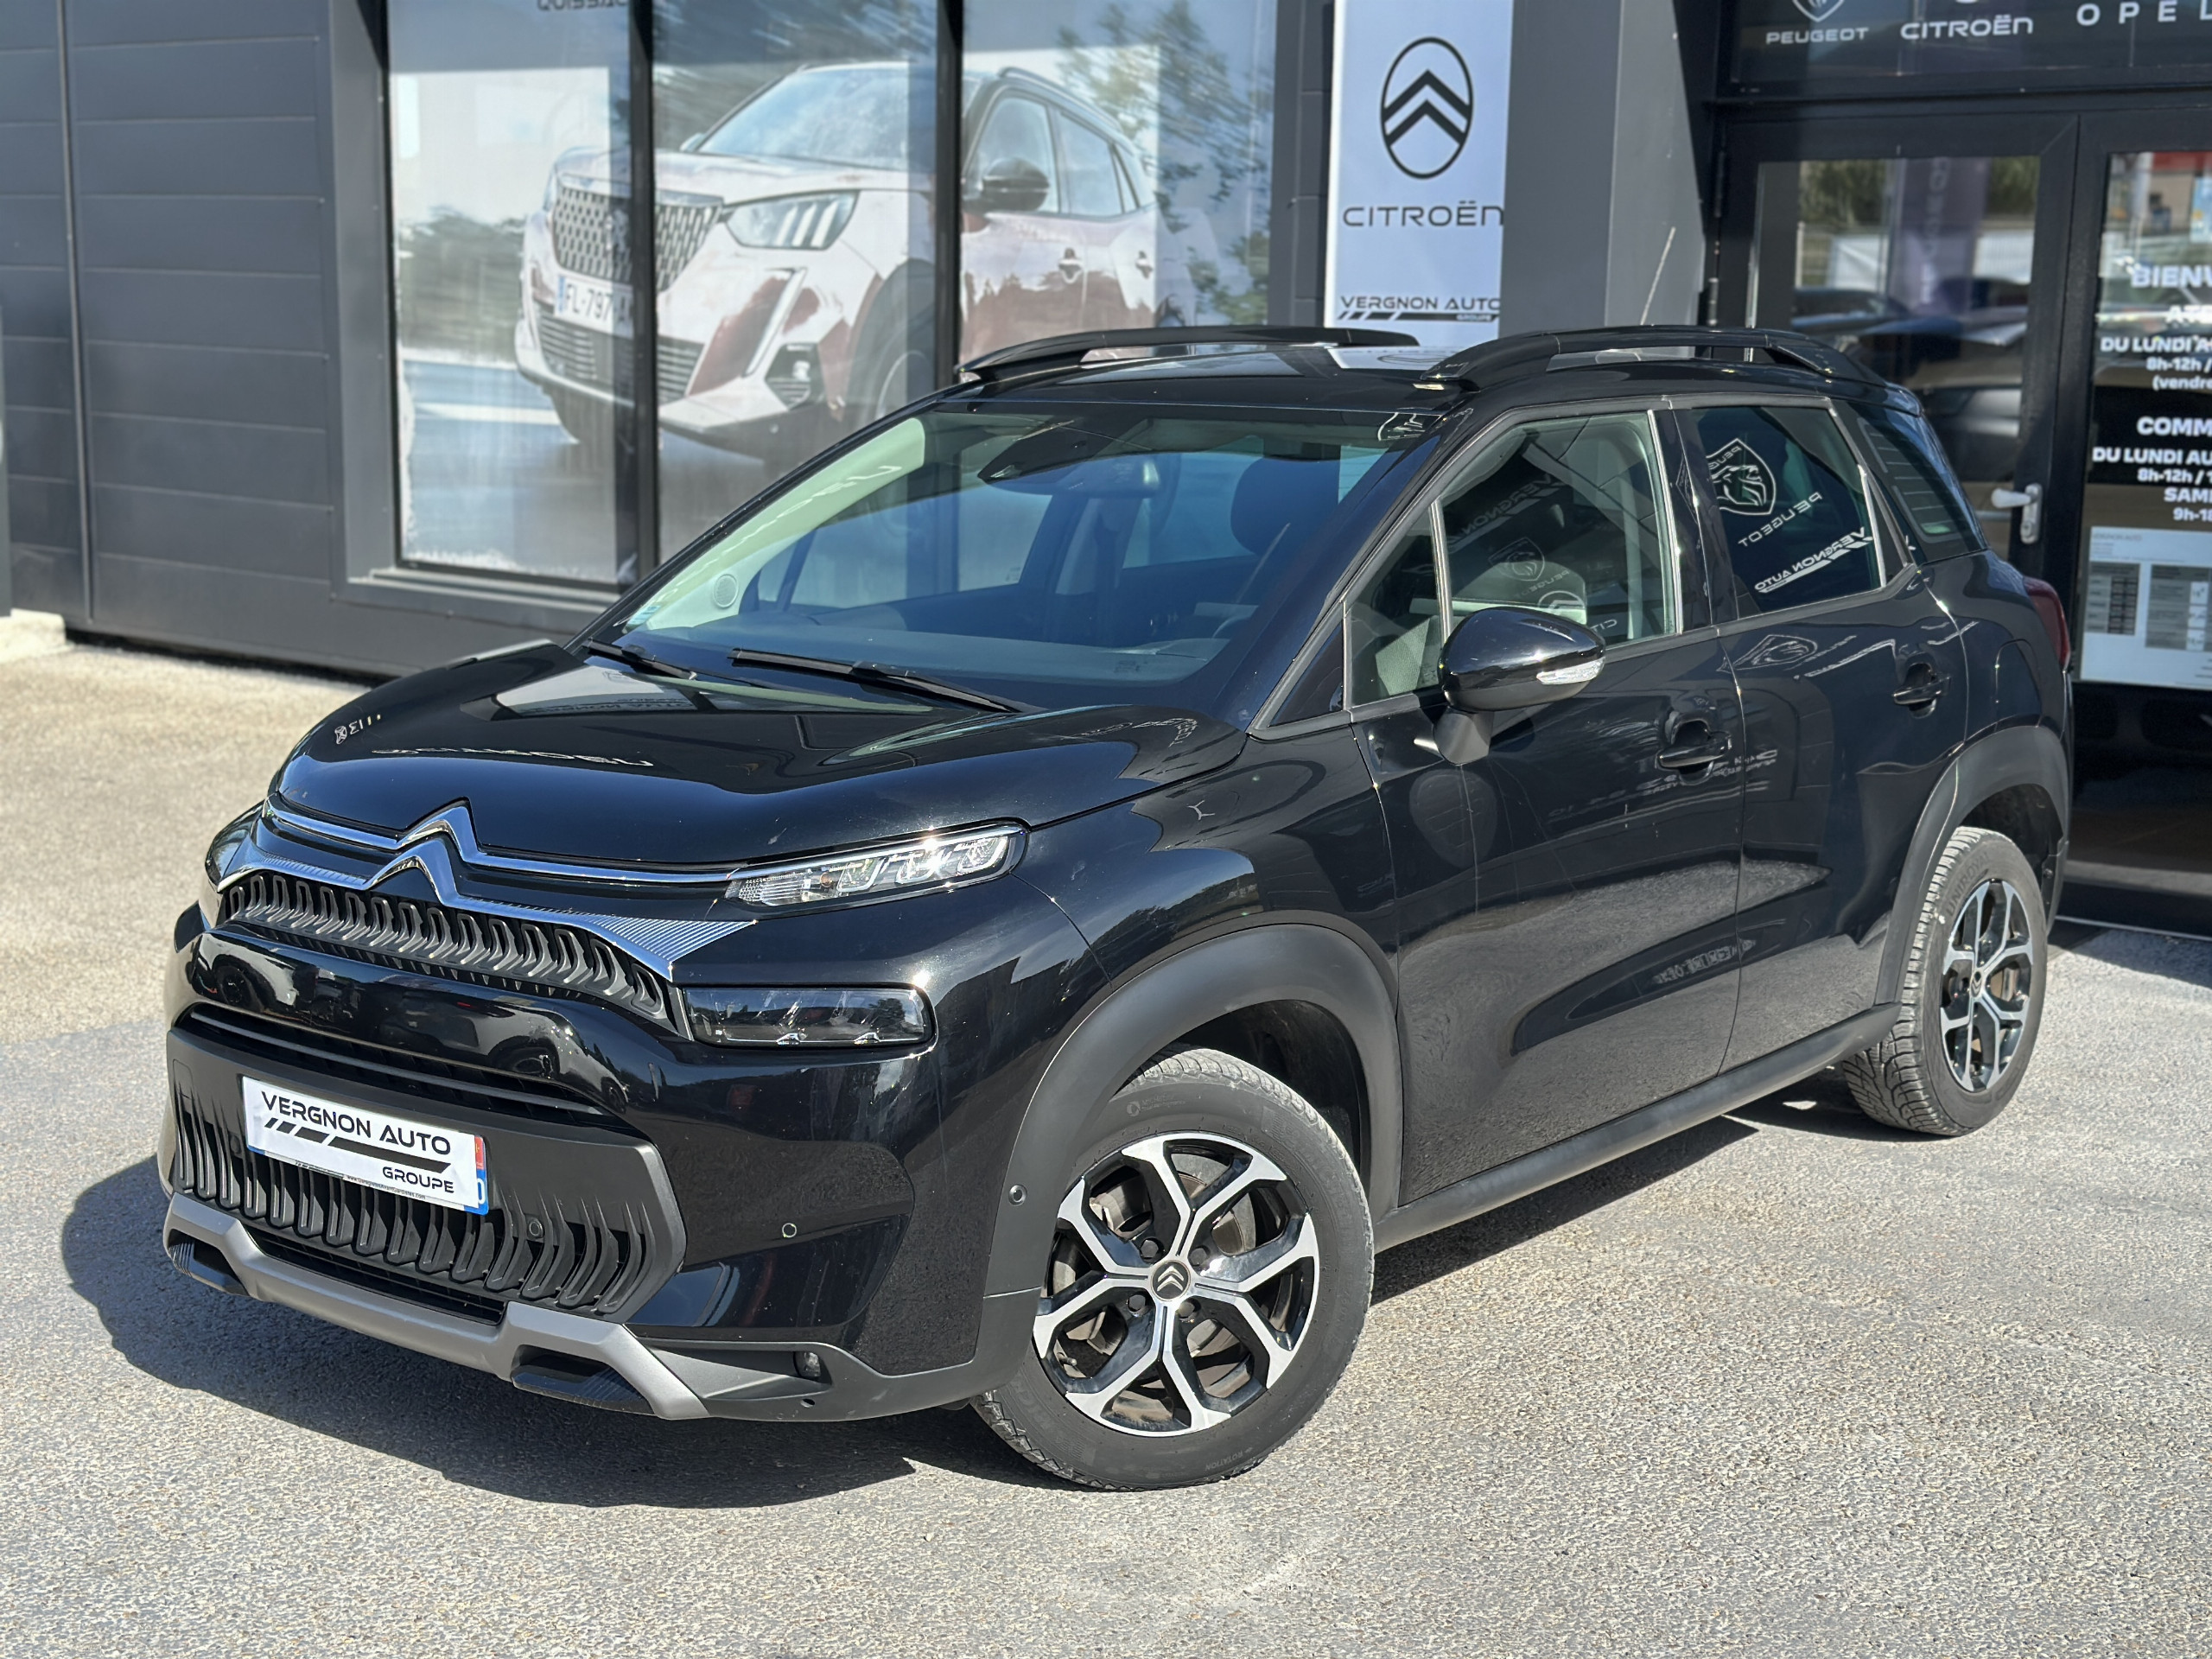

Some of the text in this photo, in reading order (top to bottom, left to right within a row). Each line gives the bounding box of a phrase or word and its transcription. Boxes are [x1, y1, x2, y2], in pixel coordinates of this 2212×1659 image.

[1765, 27, 1869, 44] PEUGEOT
[1340, 296, 1501, 311] VERGNON AUTO
[2100, 336, 2129, 353] DU
[2132, 336, 2192, 353] LUNDI
[2146, 357, 2202, 372] 8h-12h
[2137, 416, 2212, 437] COMM
[2092, 447, 2121, 462] DU
[2123, 448, 2183, 465] LUNDI
[2137, 467, 2193, 484] 8h-12h
[2164, 486, 2212, 504] SAM
[261, 1090, 451, 1155] VERGNON AUTO
[383, 1166, 454, 1194] GROUPE
[1205, 1450, 1243, 1471] ROTATION
